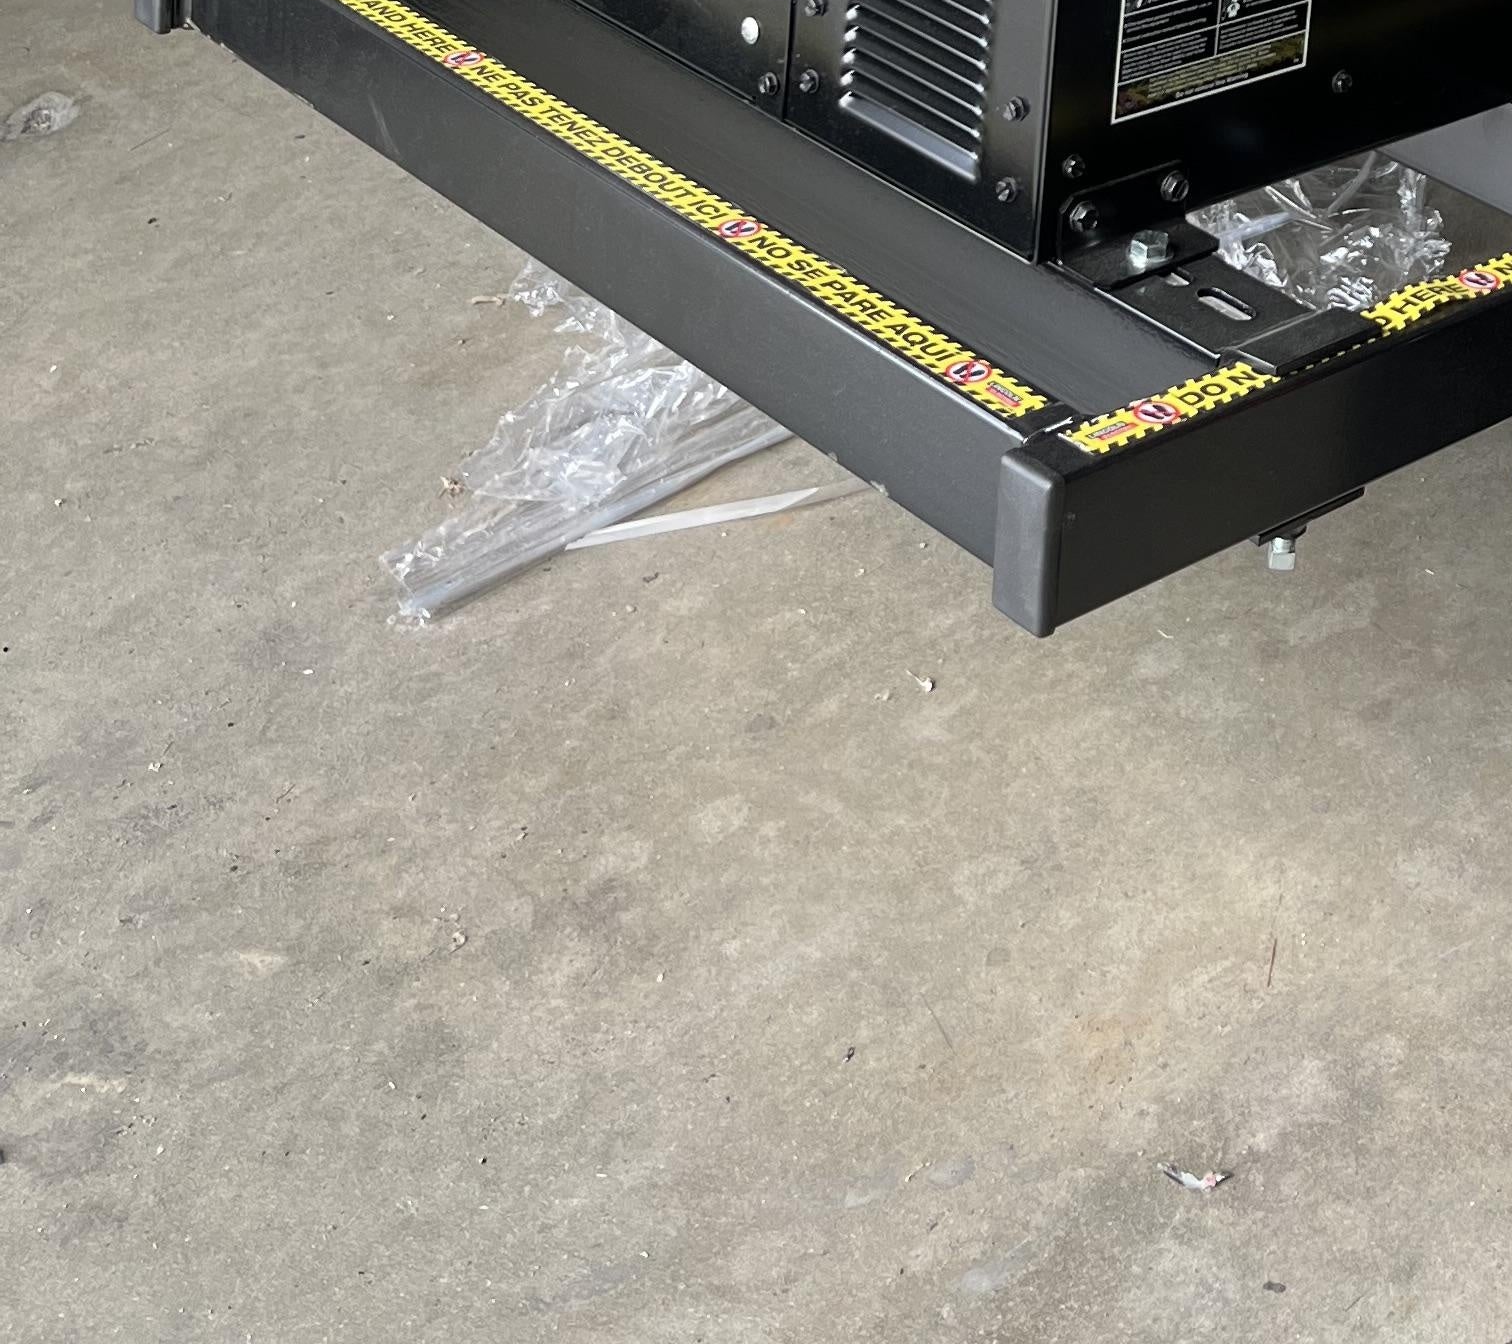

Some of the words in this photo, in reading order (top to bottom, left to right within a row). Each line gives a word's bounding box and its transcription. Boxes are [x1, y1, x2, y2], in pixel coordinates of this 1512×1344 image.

[400, 23, 460, 54] HERE
[471, 64, 508, 84] NE
[502, 83, 545, 108] PAS
[540, 105, 612, 148] TENEZ
[600, 146, 697, 200] DEBOUT
[687, 199, 731, 221] ICI
[748, 235, 793, 260] NO
[787, 259, 829, 281] SE
[819, 279, 894, 323] PARE
[1390, 282, 1469, 315] HERE
[1178, 382, 1229, 407] DO
